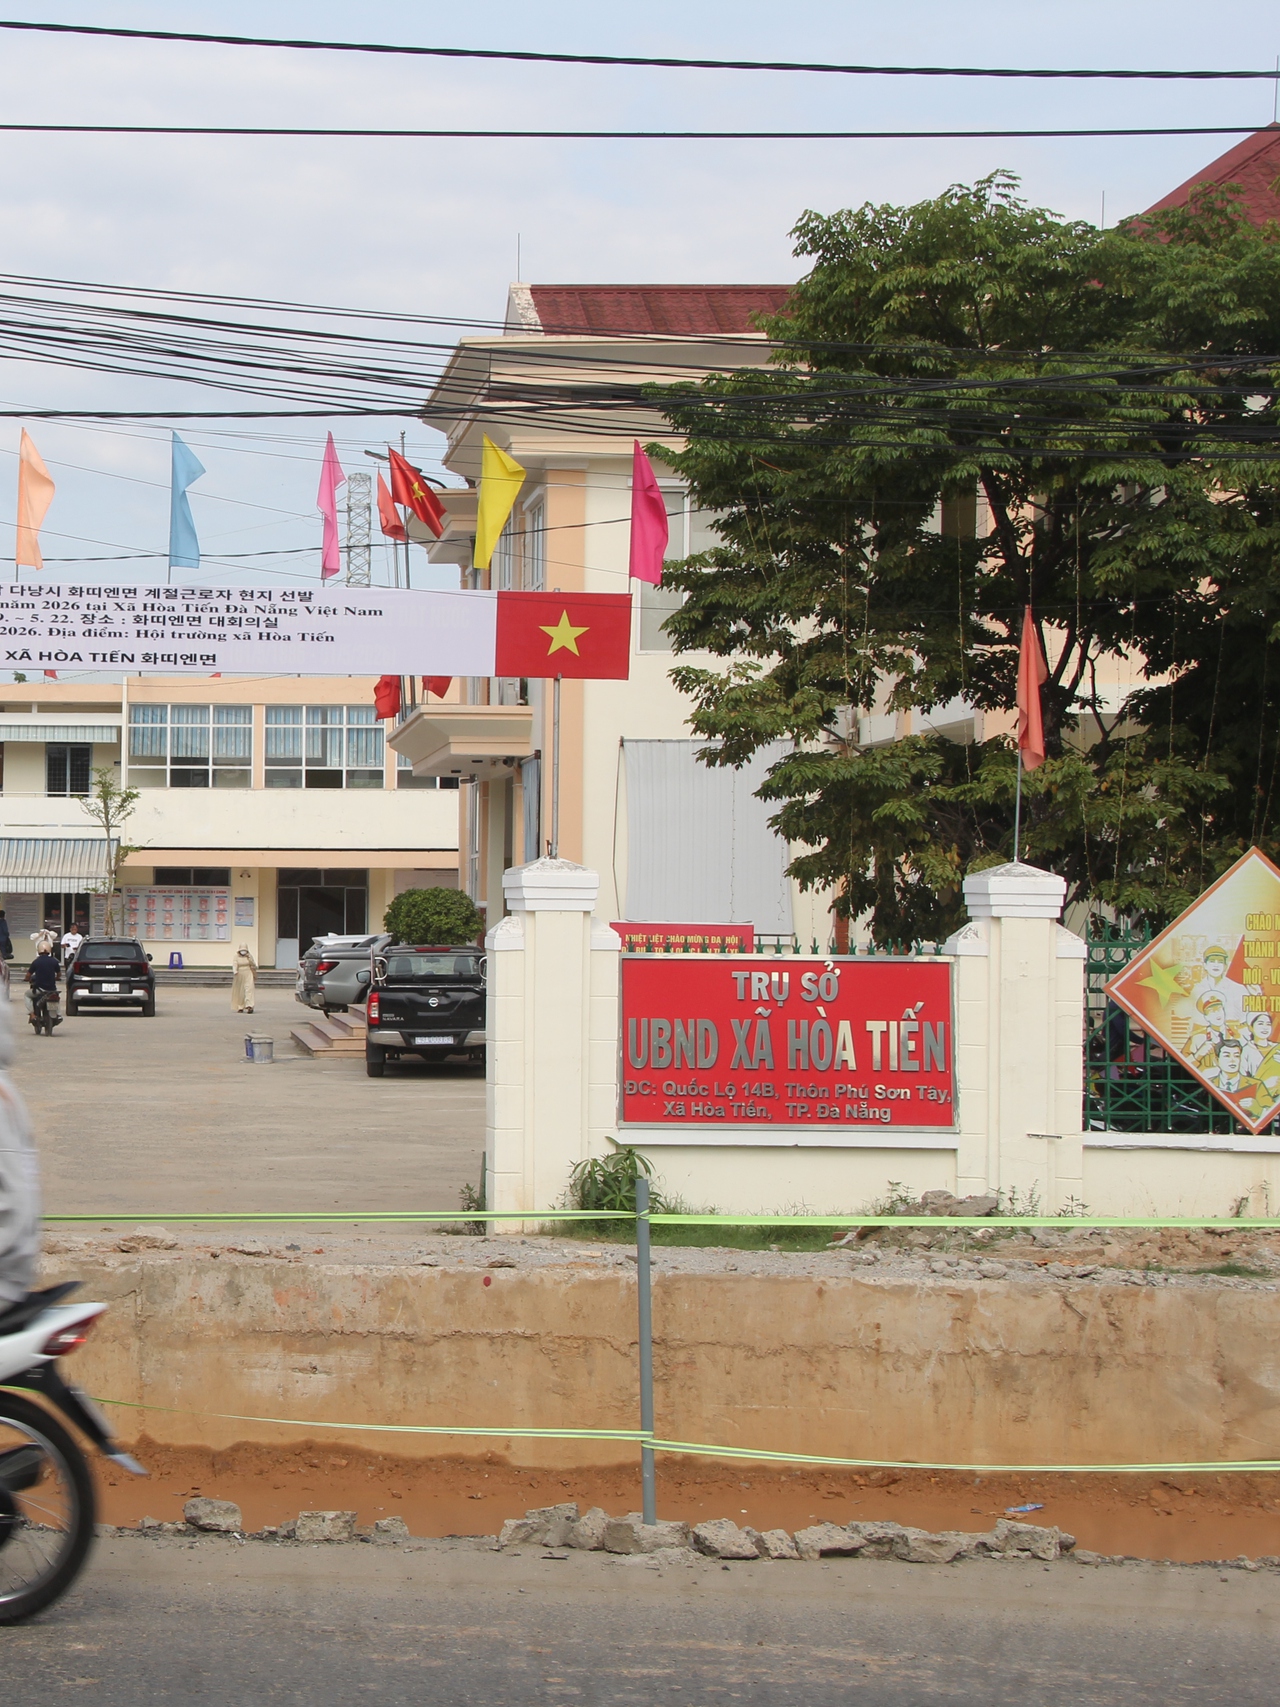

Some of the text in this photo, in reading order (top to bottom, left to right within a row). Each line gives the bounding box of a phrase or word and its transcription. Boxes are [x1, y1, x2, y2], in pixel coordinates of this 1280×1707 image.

[10, 585, 61, 597] 다낭시
[68, 586, 138, 599] 화띠엔면
[144, 588, 233, 601] 계절근로자
[239, 590, 272, 602] 현지
[280, 590, 314, 602] 선발
[0, 600, 36, 610] năm
[41, 601, 81, 611] 2026
[86, 601, 107, 613] tại
[113, 602, 136, 612] Xã
[142, 602, 176, 613] Hòa
[182, 602, 219, 613] Tiến
[225, 604, 248, 614] Đà
[254, 603, 298, 617] Nẵng
[304, 606, 338, 618] Việt
[343, 606, 384, 617] Nam
[30, 614, 44, 623] 5.
[50, 614, 74, 624] 22.
[80, 613, 115, 625] 장소
[132, 614, 202, 627] 화띠엔면
[209, 616, 278, 629] 대회의실
[48, 627, 76, 639] Địa
[82, 626, 129, 638] điểm:
[135, 629, 165, 641] Hội
[171, 630, 227, 642] trường
[233, 632, 251, 641] xã
[258, 632, 292, 642] Hòa
[298, 631, 335, 642] Tiến
[5, 649, 32, 661] XÃ
[38, 649, 83, 662] HÒA
[89, 650, 135, 663] TIẾN
[141, 652, 217, 666] 화띠엔면
[1246, 911, 1272, 931] CHÀO
[725, 935, 738, 945] HỘI
[1243, 938, 1275, 957] THÀNH
[731, 961, 841, 1007] TRỤ SỞ
[1243, 965, 1261, 985] MỚI
[1242, 993, 1267, 1012] PHÁT
[627, 1001, 946, 1072] UBND XÃ HÒA TIẾN
[624, 1078, 952, 1104] ĐC: Quốc Lộ 14B, Thôn Phú Sơn Tây,
[663, 1100, 892, 1122] Xã Hòa Tiến, TP. Đà Nẵng
